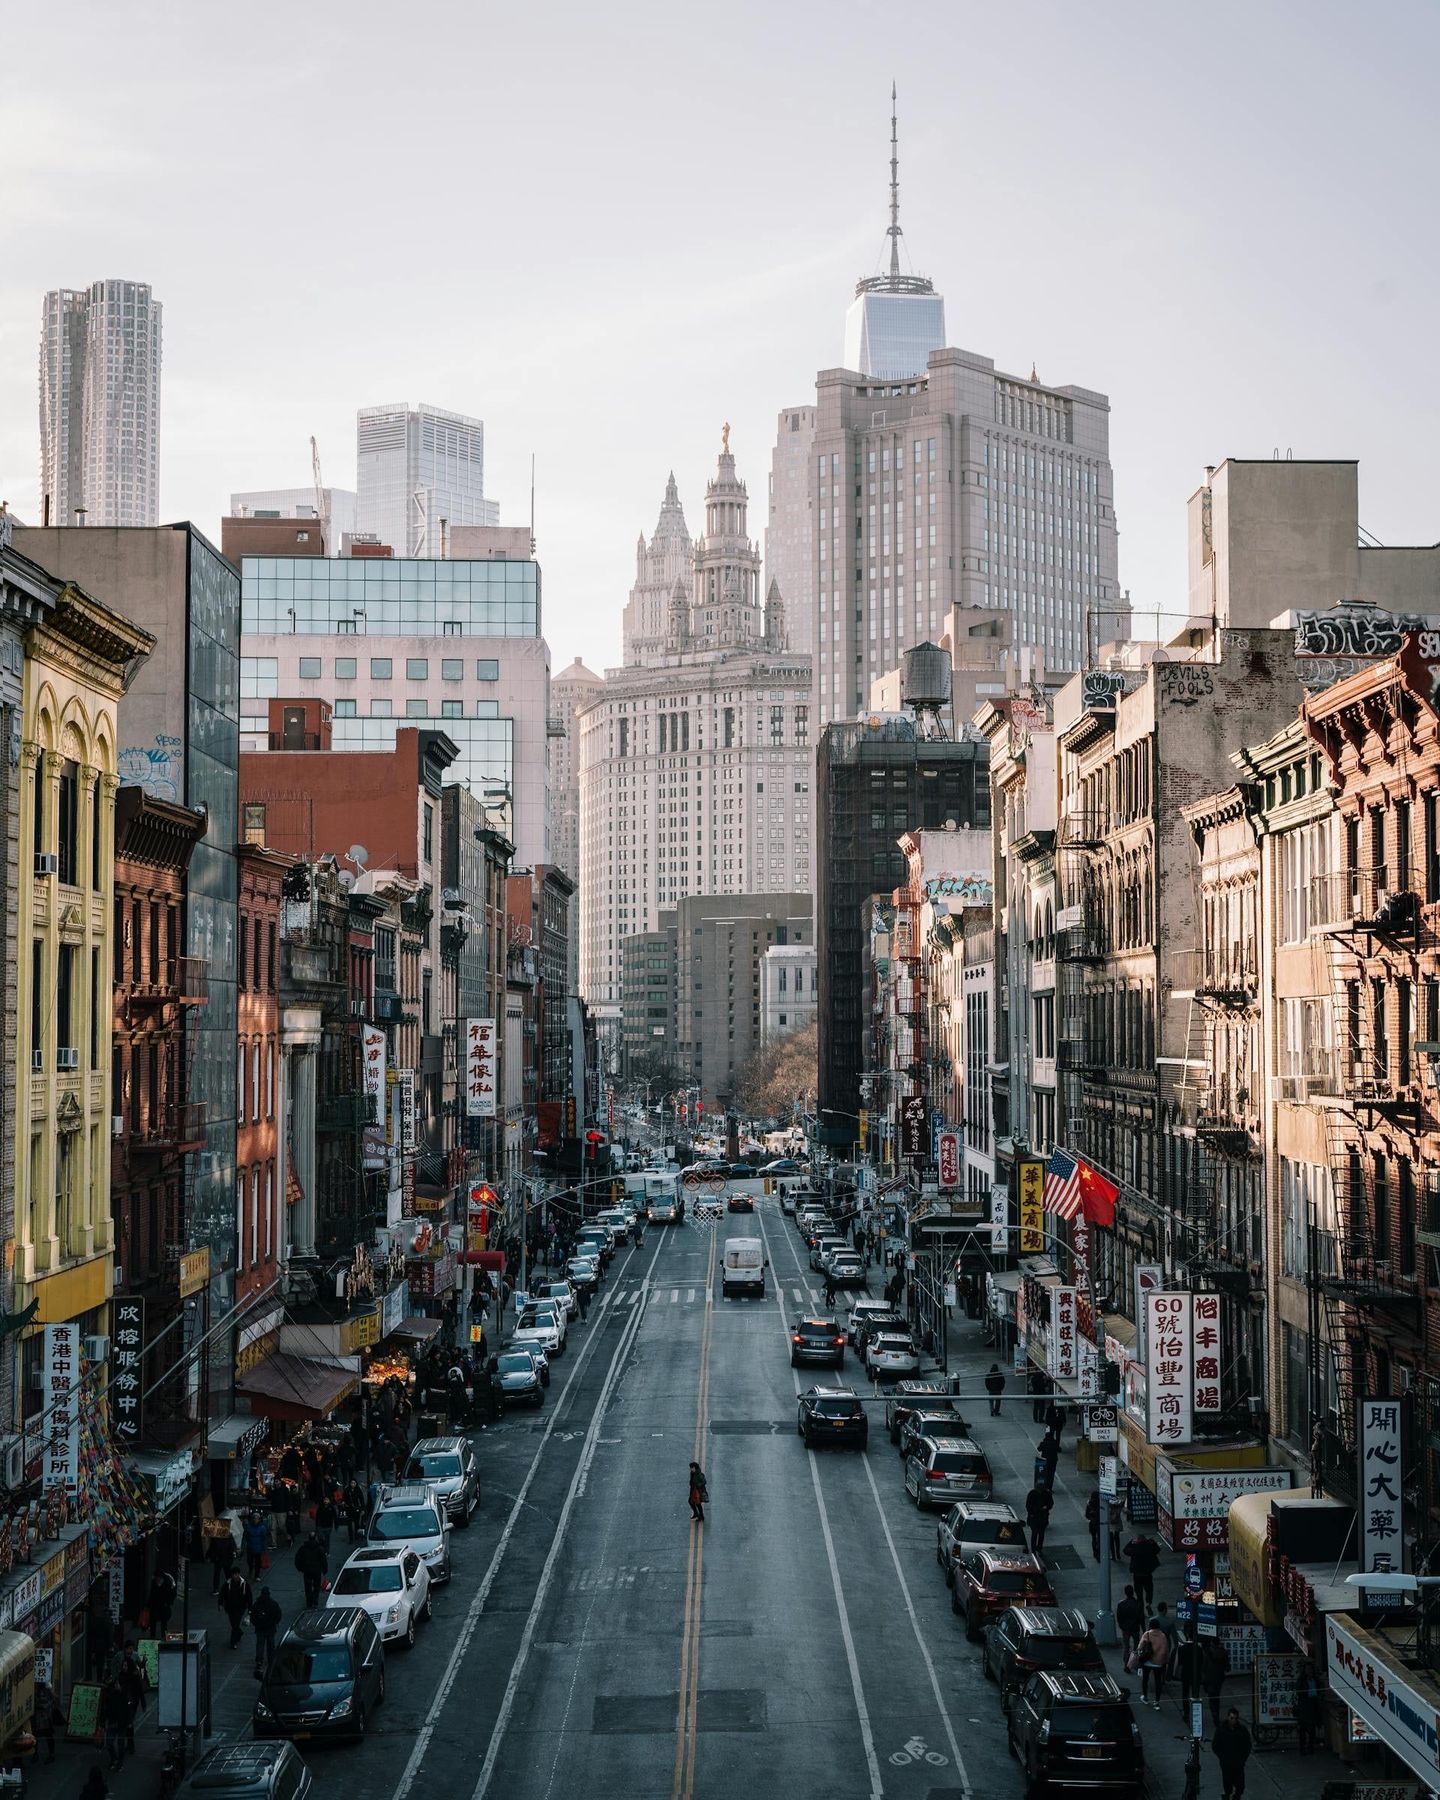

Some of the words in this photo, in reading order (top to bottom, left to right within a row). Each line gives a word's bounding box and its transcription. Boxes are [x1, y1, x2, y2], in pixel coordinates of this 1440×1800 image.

[1168, 679, 1213, 695] FOOLS
[1023, 1167, 1041, 1249] 華美商場
[1177, 1611, 1191, 1619] M22
